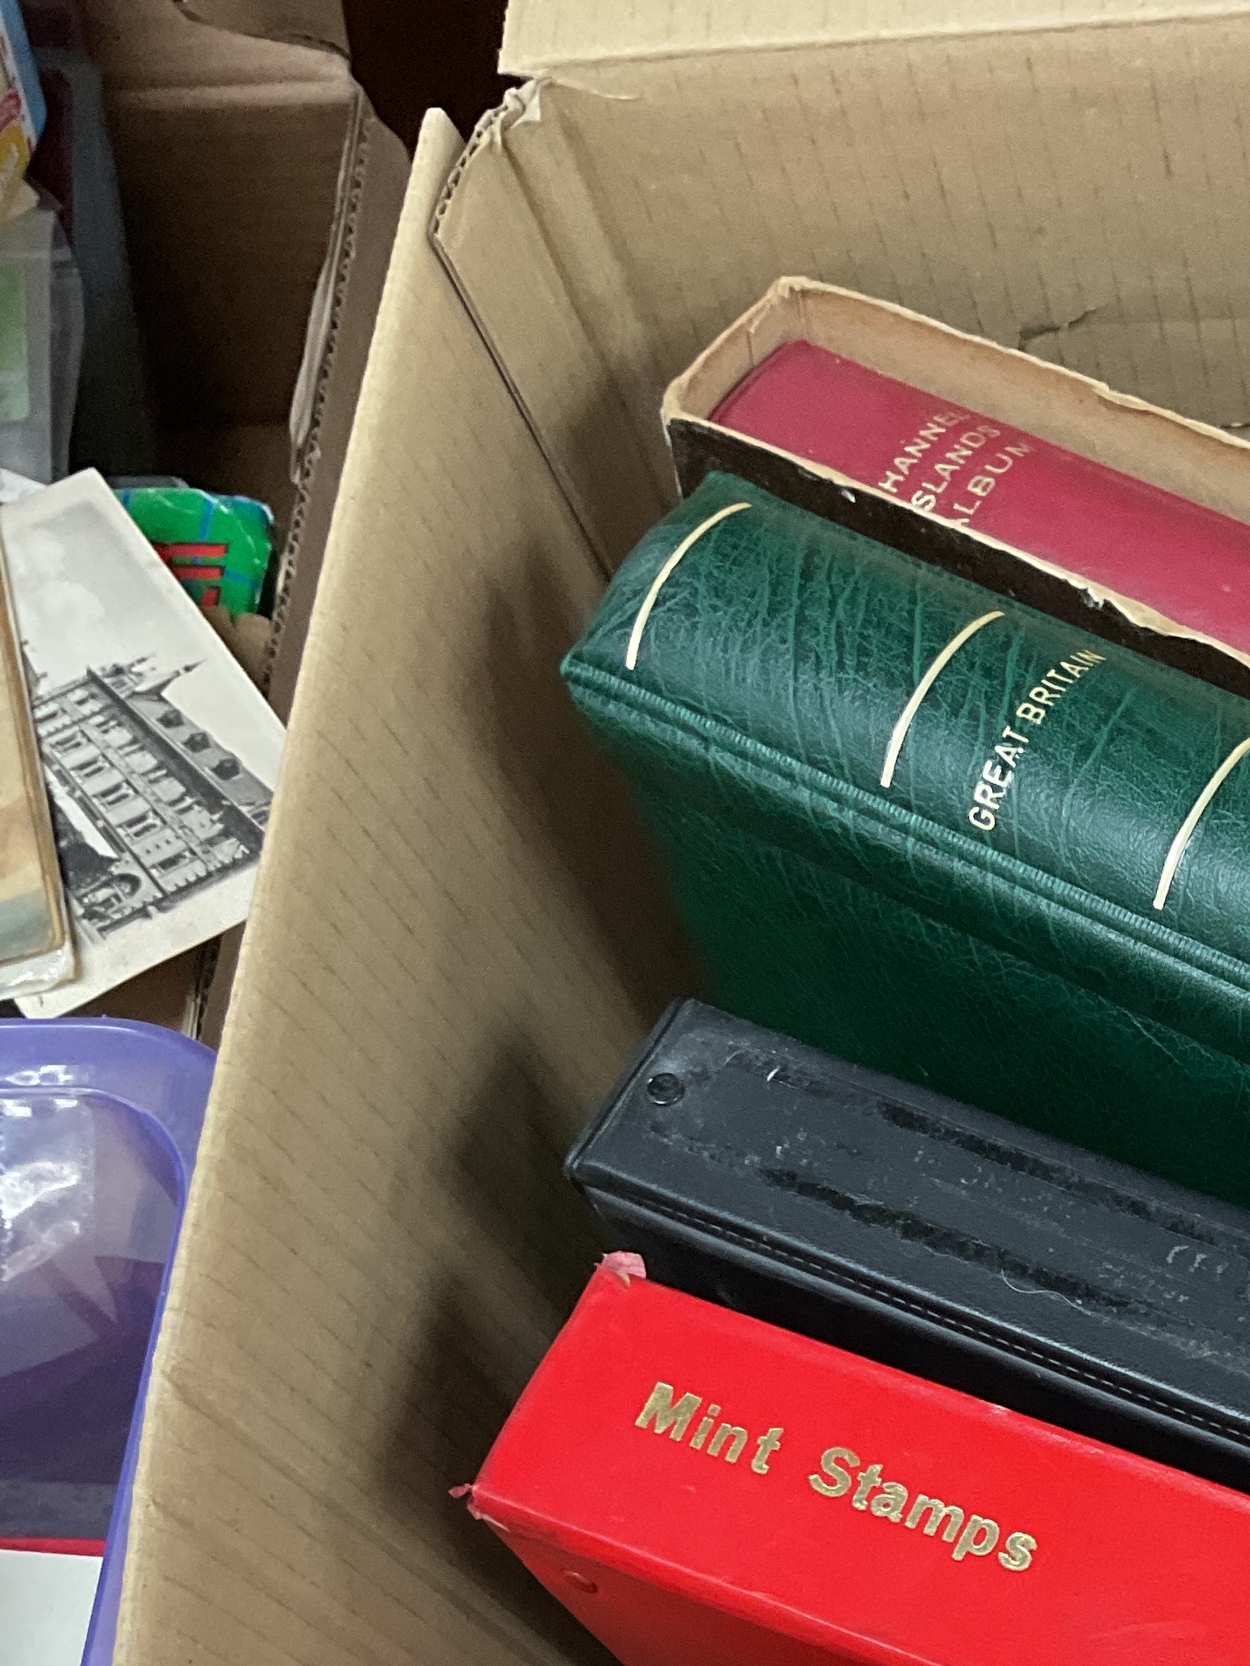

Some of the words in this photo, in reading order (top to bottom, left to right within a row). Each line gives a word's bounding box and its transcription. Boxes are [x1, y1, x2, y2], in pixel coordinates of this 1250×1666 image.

[878, 411, 972, 493] HANNEL
[911, 424, 1001, 512] SLANDS
[968, 725, 1030, 831] GREAT
[1016, 649, 1107, 725] BRITAIN
[634, 1381, 784, 1475] Mint
[808, 1446, 1038, 1572] Stamps
